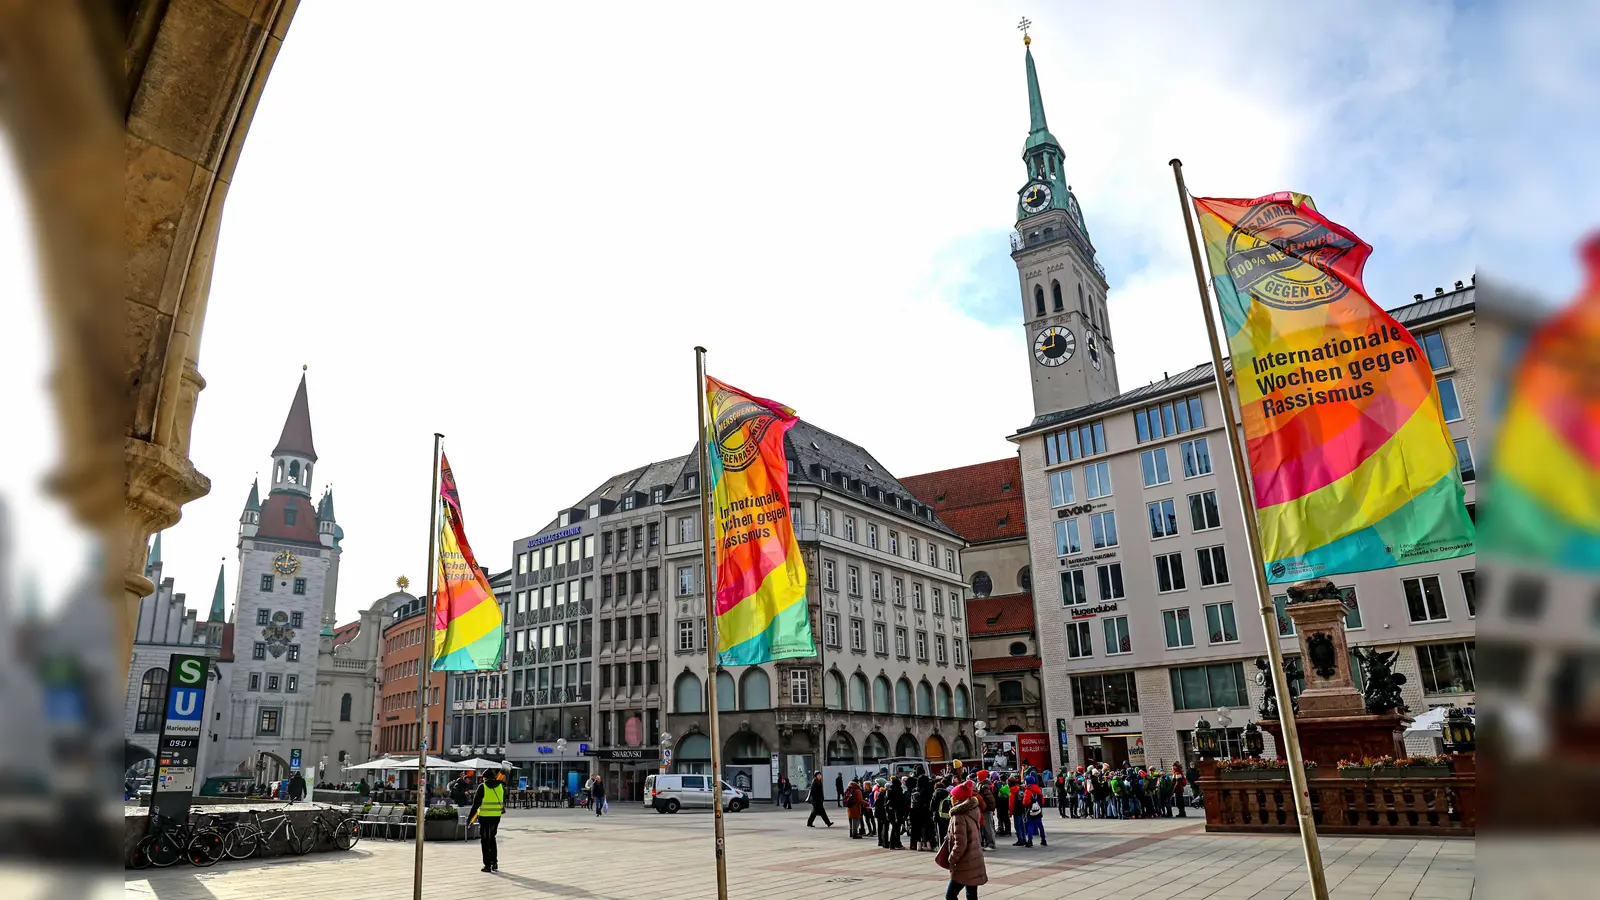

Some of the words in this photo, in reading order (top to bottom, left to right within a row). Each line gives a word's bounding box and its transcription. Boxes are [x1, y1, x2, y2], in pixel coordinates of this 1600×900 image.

[1231, 257, 1266, 279] 100%
[1264, 280, 1309, 298] GEGEN
[1315, 277, 1341, 295] RAS
[1252, 325, 1401, 374] Internationale
[1256, 366, 1343, 396] Wochen
[1348, 346, 1418, 380] gegen
[1262, 381, 1374, 418] Rassismus
[719, 406, 760, 431] MENSCHENW
[757, 506, 786, 525] gegen
[1071, 603, 1118, 617] Hugendubel
[179, 659, 201, 684] S
[175, 691, 197, 716] U
[1084, 718, 1129, 728] Hugendubel
[292, 758, 299, 766] U
[293, 750, 300, 758] S
[612, 750, 642, 758] SWAROVSKI
